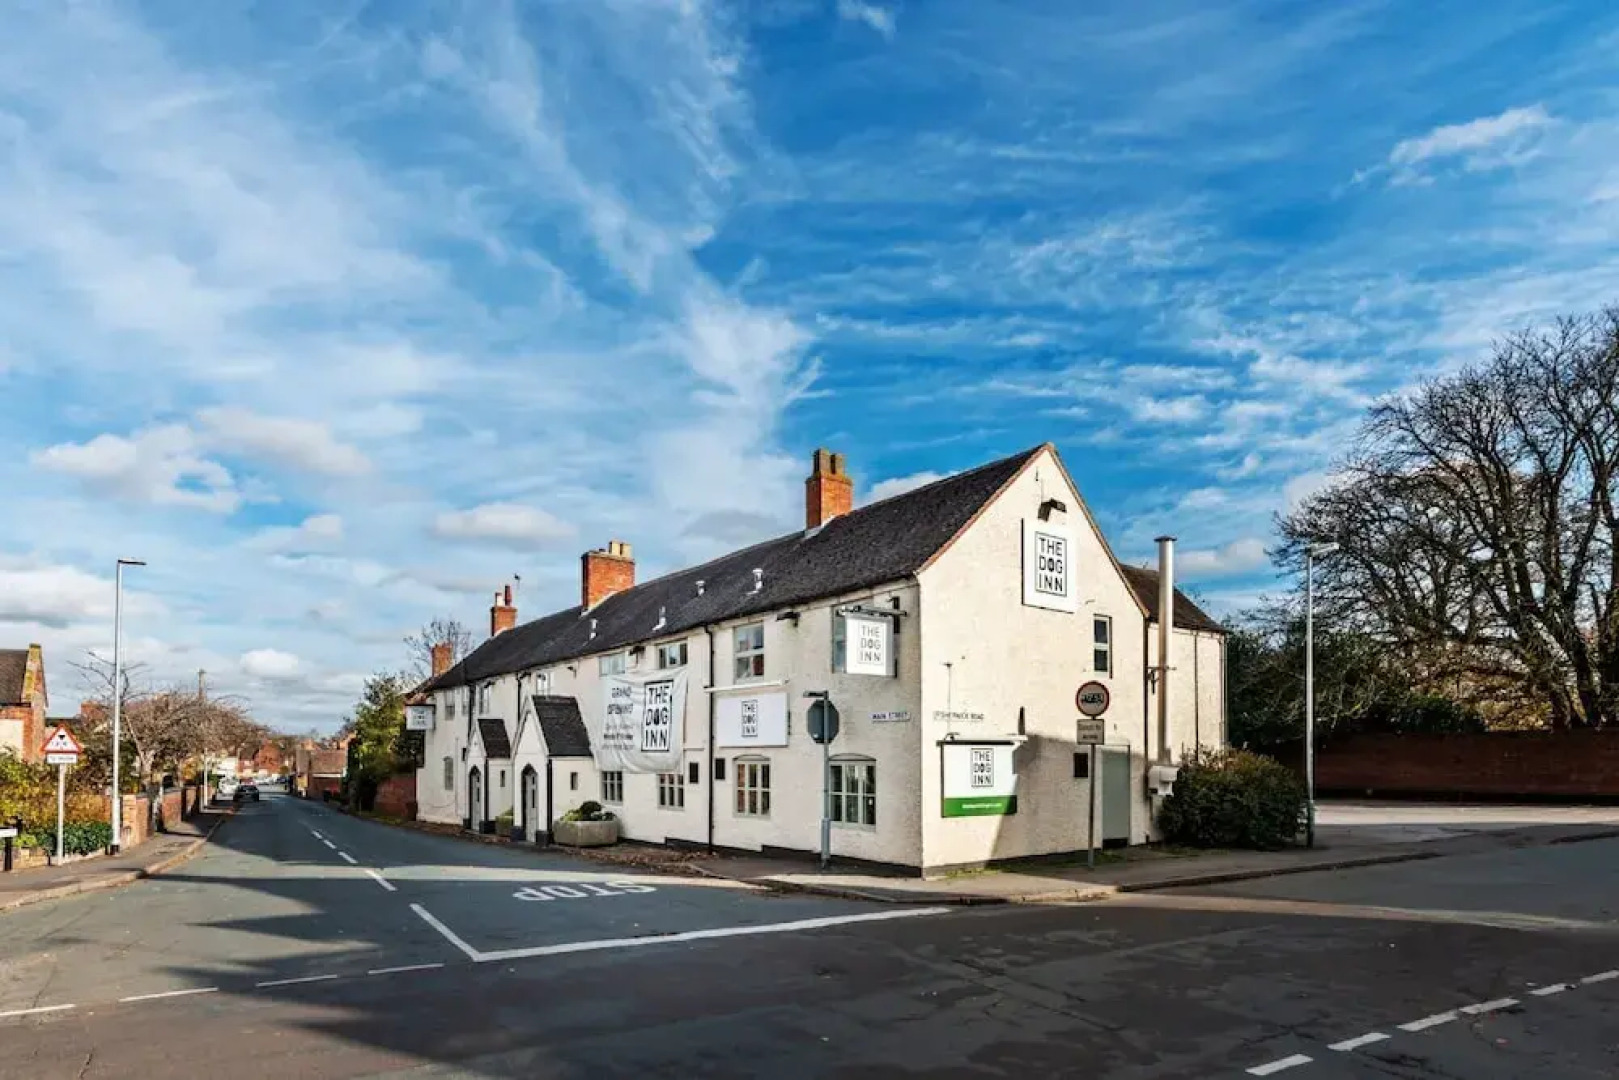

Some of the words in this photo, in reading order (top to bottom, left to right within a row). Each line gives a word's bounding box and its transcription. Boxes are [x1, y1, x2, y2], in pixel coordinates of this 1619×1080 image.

[1039, 537, 1062, 557] THE
[1039, 555, 1062, 574] DOG
[1039, 573, 1062, 592] INN
[861, 625, 880, 638] THE
[861, 638, 881, 650] DOG
[861, 651, 881, 662] INN
[649, 686, 670, 704] THE
[743, 703, 756, 712] THE
[646, 707, 668, 726] DOG
[743, 713, 756, 724] DOG
[743, 725, 756, 734] INN
[646, 729, 668, 748] INN
[973, 751, 990, 762] THE
[973, 763, 992, 773] DOG
[973, 775, 991, 785] INN
[512, 880, 657, 901] STOP
